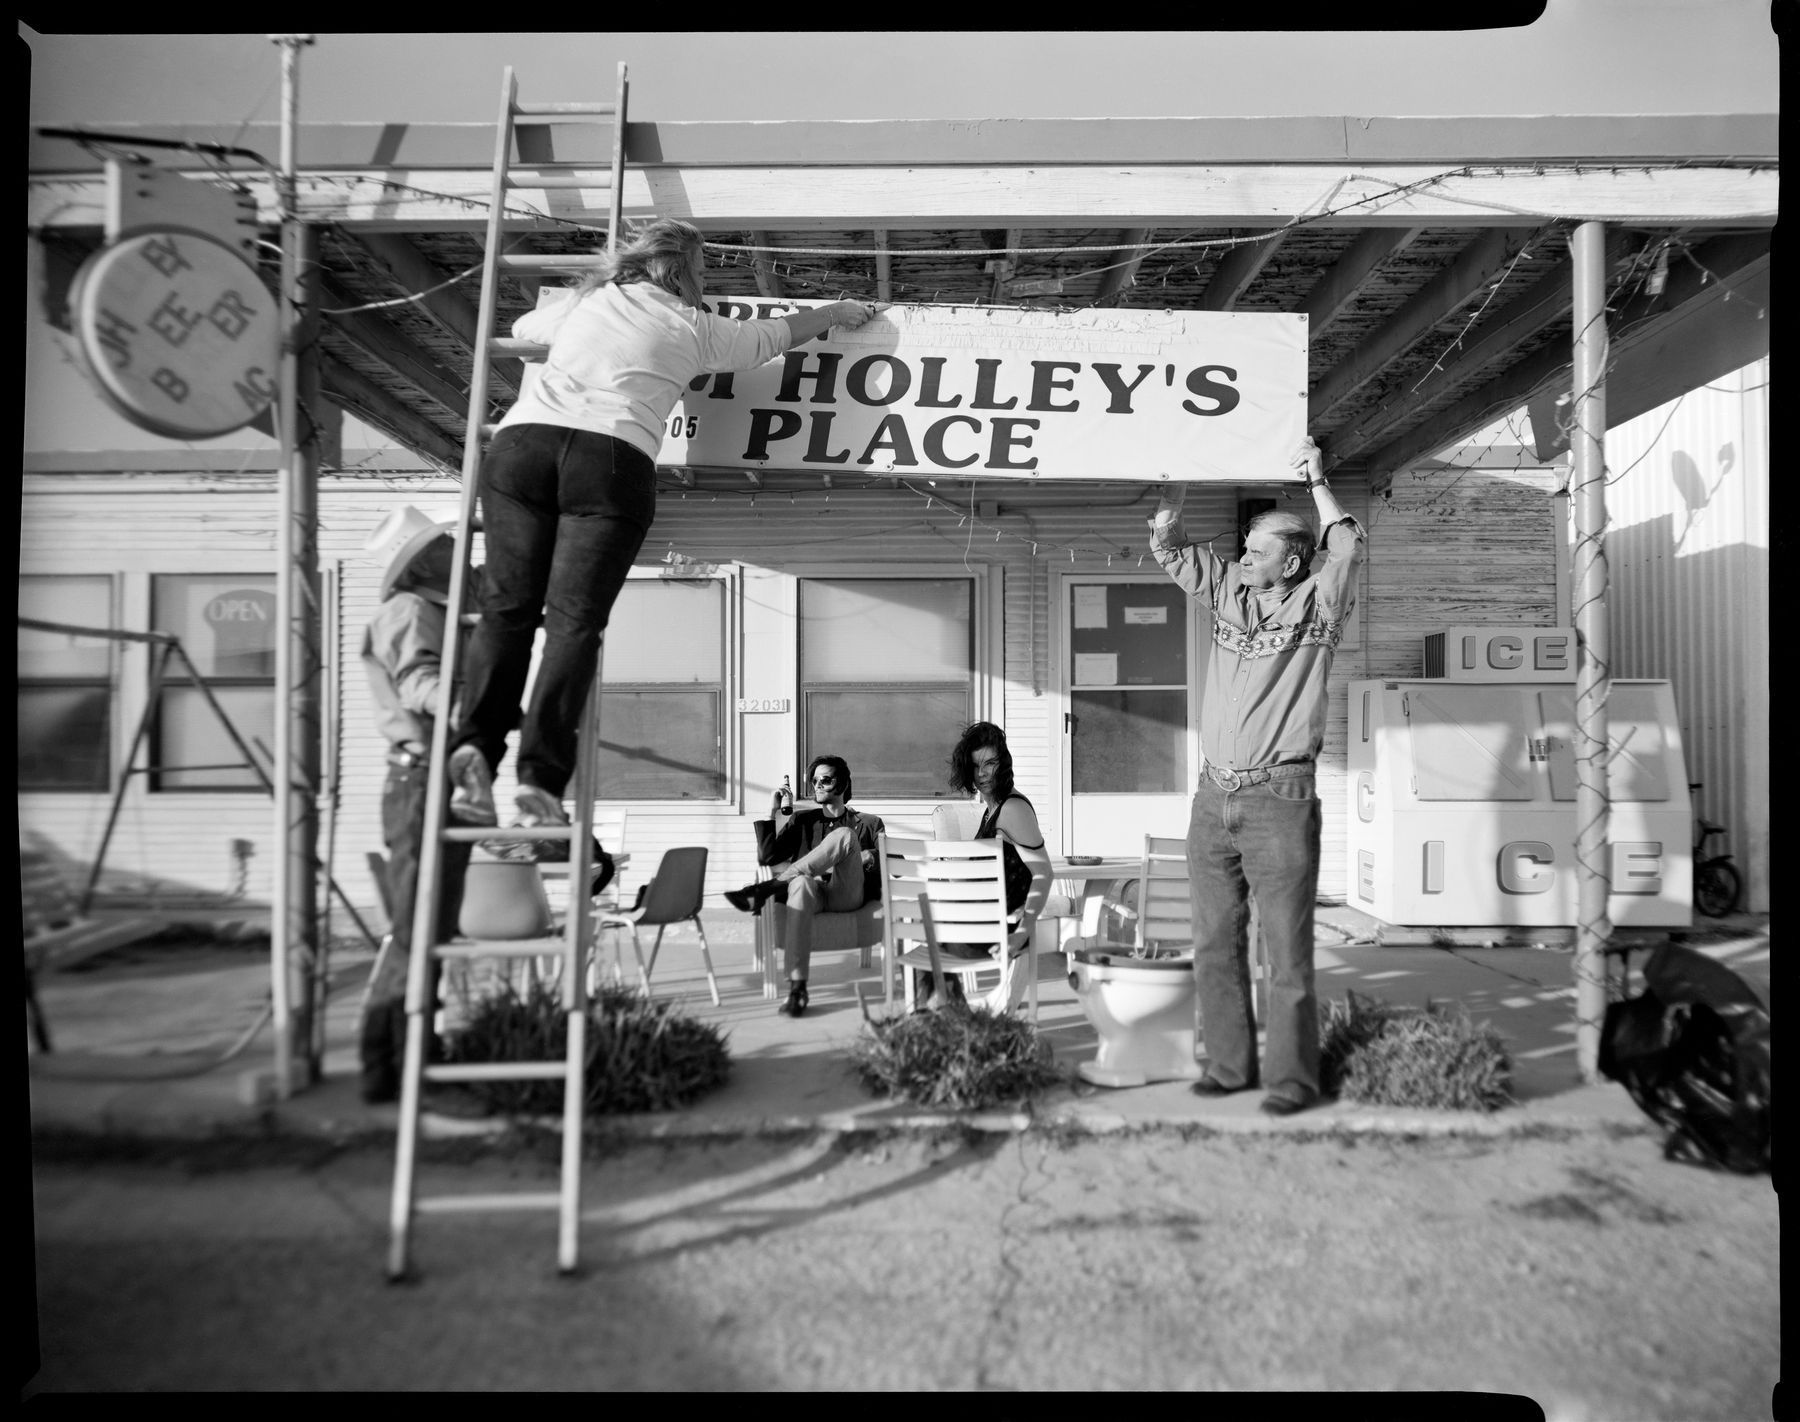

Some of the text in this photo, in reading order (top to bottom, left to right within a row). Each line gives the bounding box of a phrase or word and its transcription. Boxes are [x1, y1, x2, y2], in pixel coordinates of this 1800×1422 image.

[775, 351, 1241, 416] HOLLEY'S
[742, 408, 1041, 470] PLACE
[208, 599, 267, 621] OPEN
[1462, 635, 1569, 671] ICE
[1422, 840, 1663, 896] ICE
